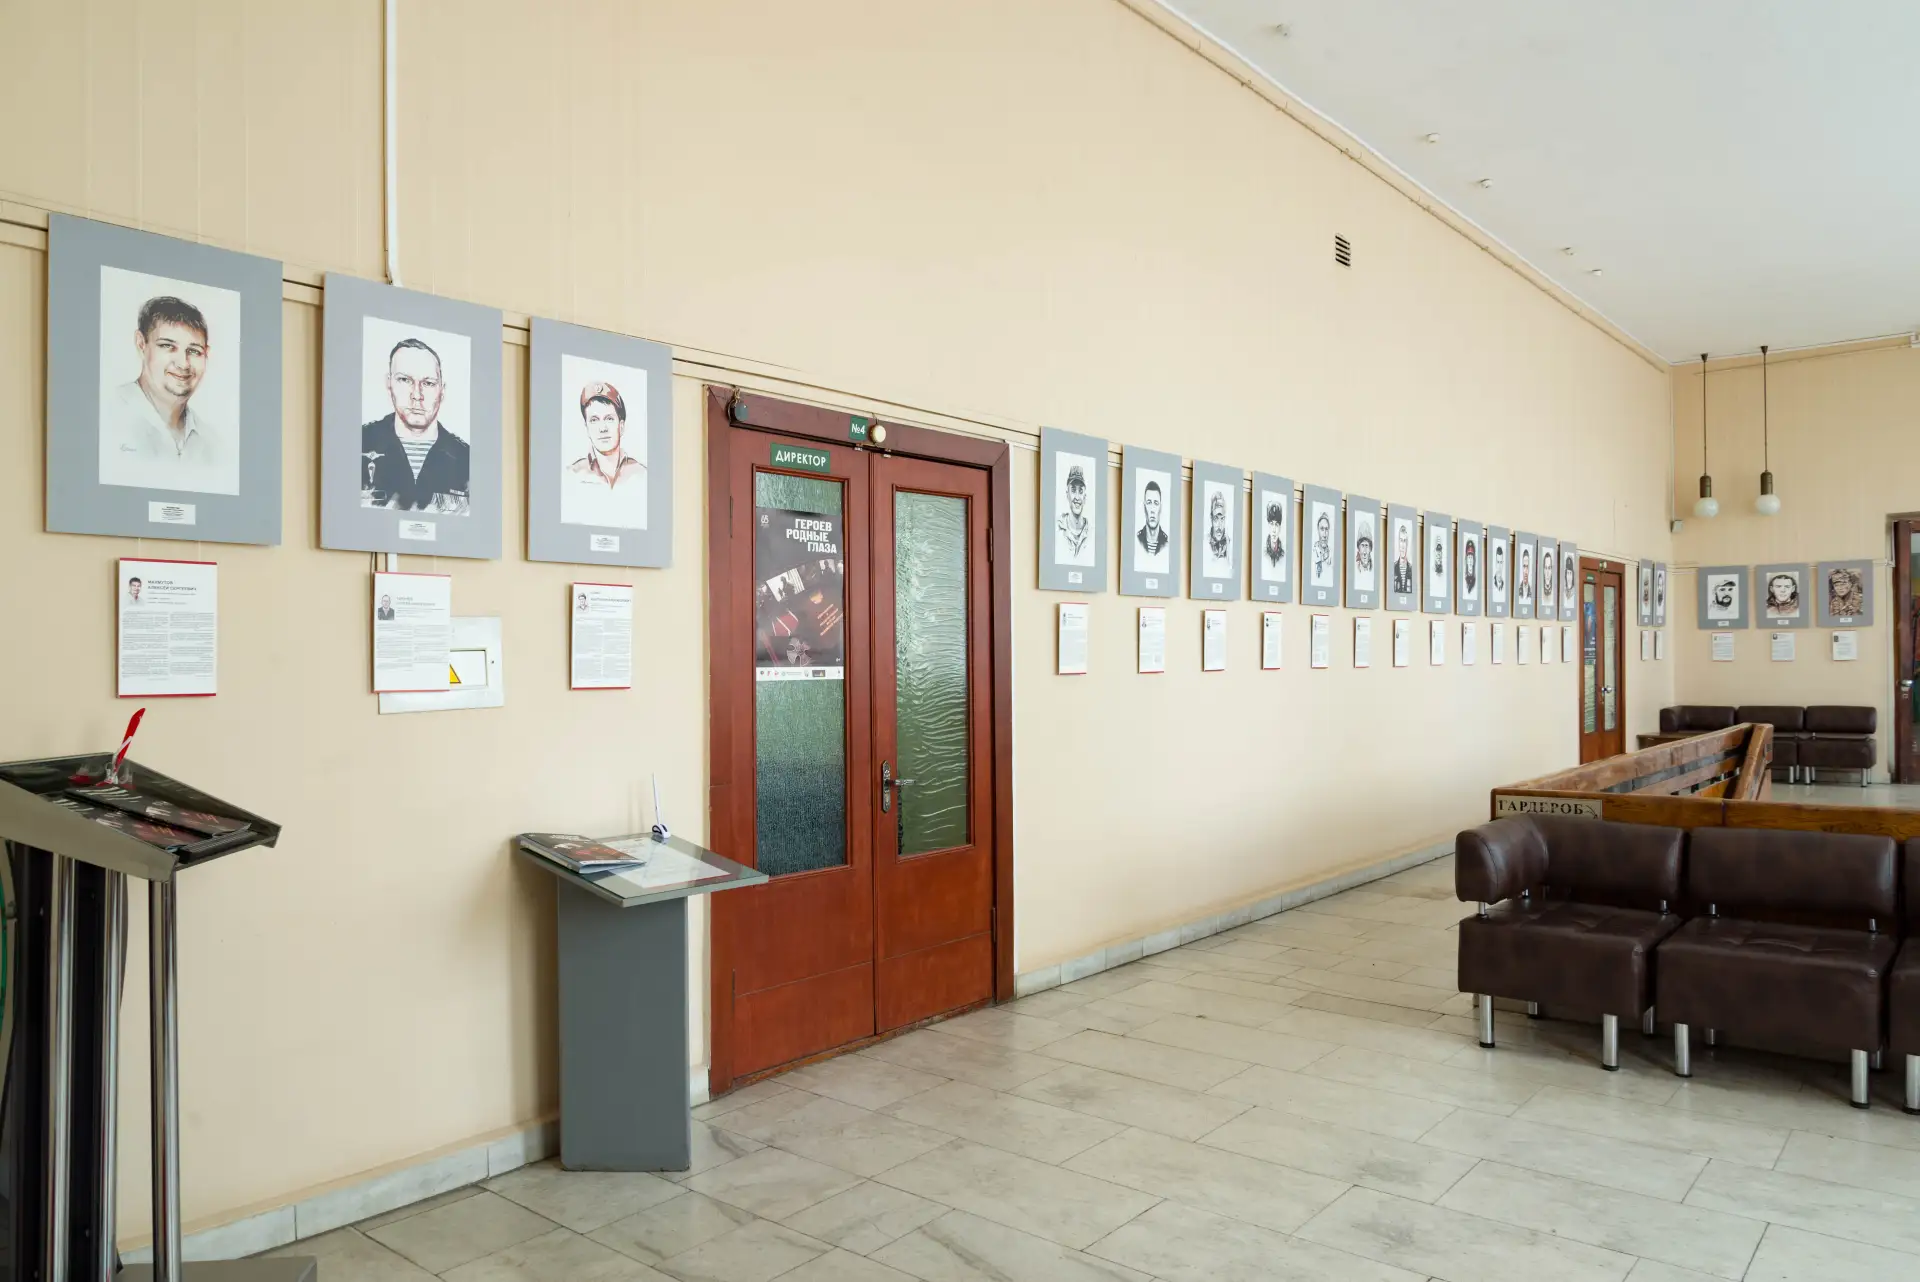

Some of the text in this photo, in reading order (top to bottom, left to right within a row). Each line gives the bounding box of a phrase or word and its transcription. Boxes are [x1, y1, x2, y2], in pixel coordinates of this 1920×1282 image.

[851, 423, 866, 435] №4
[775, 449, 827, 467] ДИРЕКТОР
[795, 518, 832, 532] ГЕРОЕВ
[786, 528, 829, 543] РОДНЫЕ
[807, 541, 837, 554] ГЛАЗА
[1497, 799, 1584, 815] ГАРДЕРОБ
